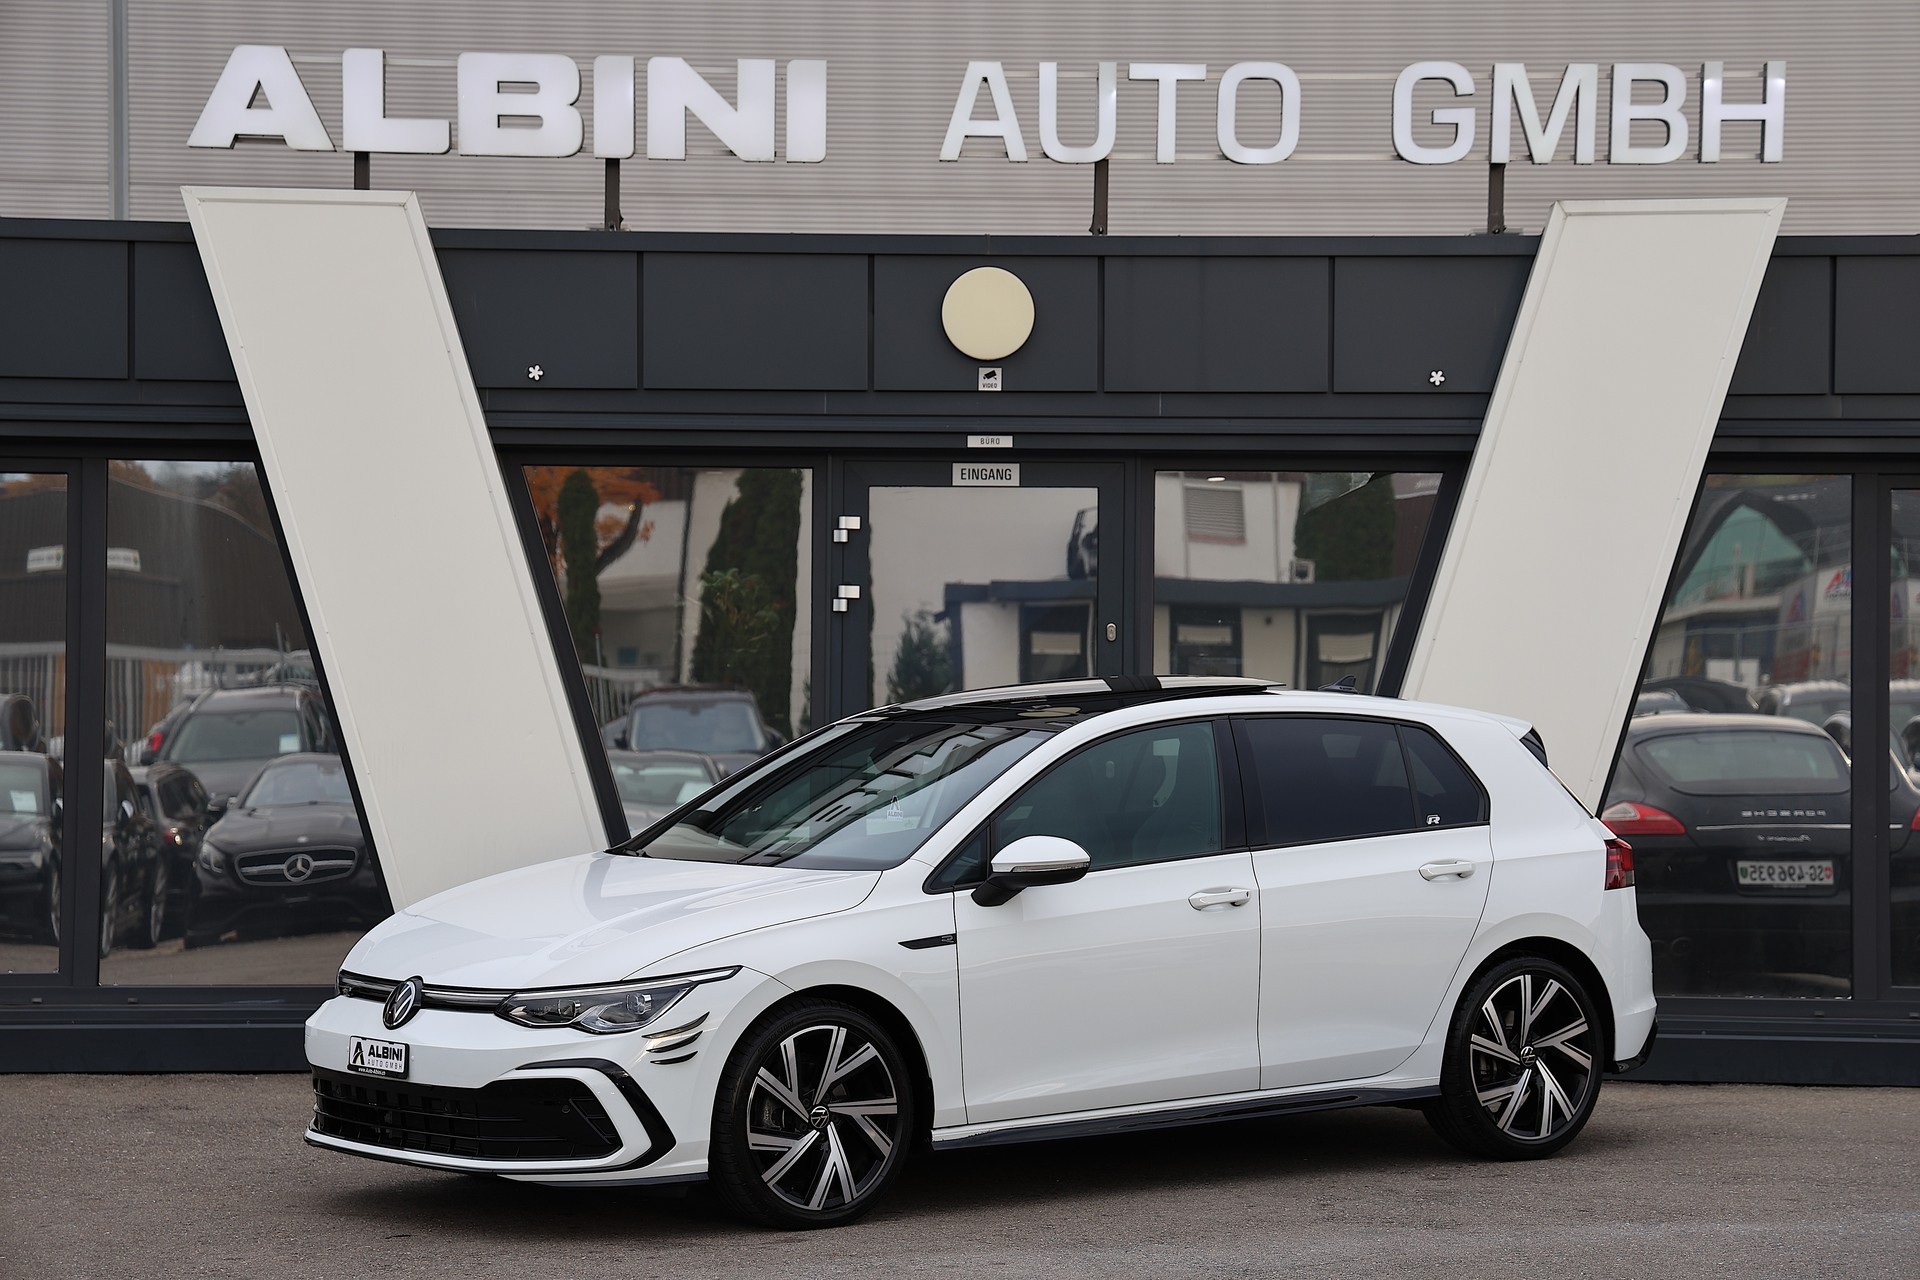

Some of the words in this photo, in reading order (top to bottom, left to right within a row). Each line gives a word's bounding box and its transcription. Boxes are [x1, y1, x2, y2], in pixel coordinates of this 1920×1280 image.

[187, 44, 827, 163] ALBINI
[938, 61, 1301, 165] AUTO
[1392, 61, 1787, 165] GMBH
[980, 437, 1001, 445] BÜRO
[960, 468, 1012, 481] EINGANG
[368, 1044, 403, 1061] ALBINI
[367, 1059, 384, 1068] AUTO
